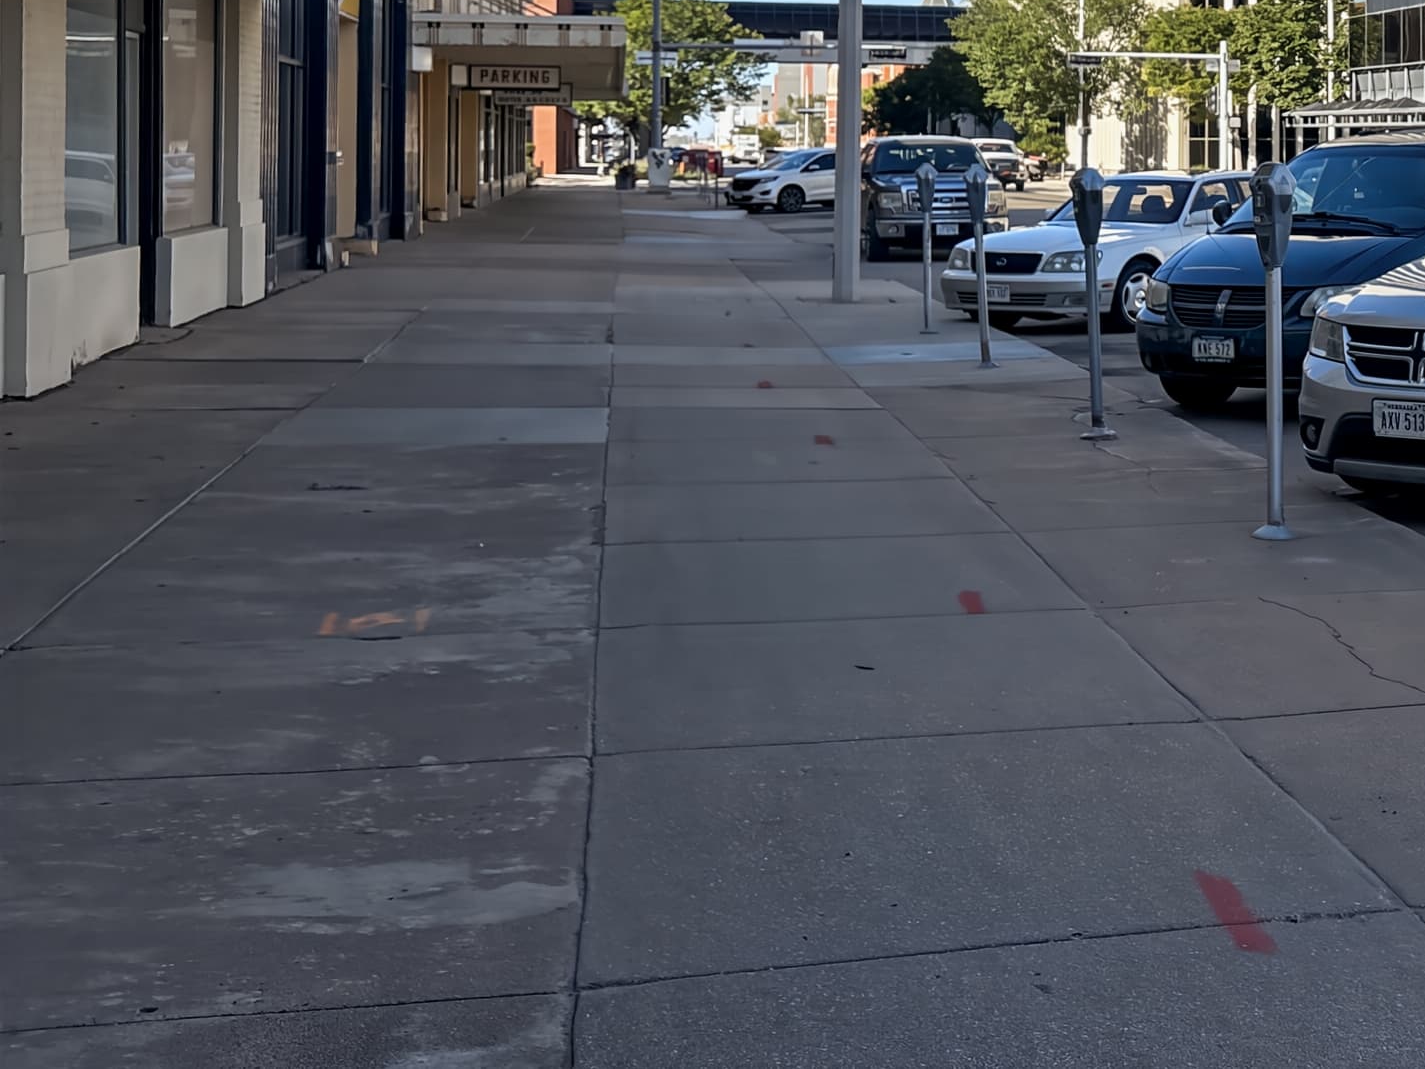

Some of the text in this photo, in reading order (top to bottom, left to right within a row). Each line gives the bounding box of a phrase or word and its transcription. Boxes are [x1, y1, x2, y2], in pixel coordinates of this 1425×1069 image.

[479, 68, 551, 85] PARKING
[1381, 411, 1425, 432] AXV 513
